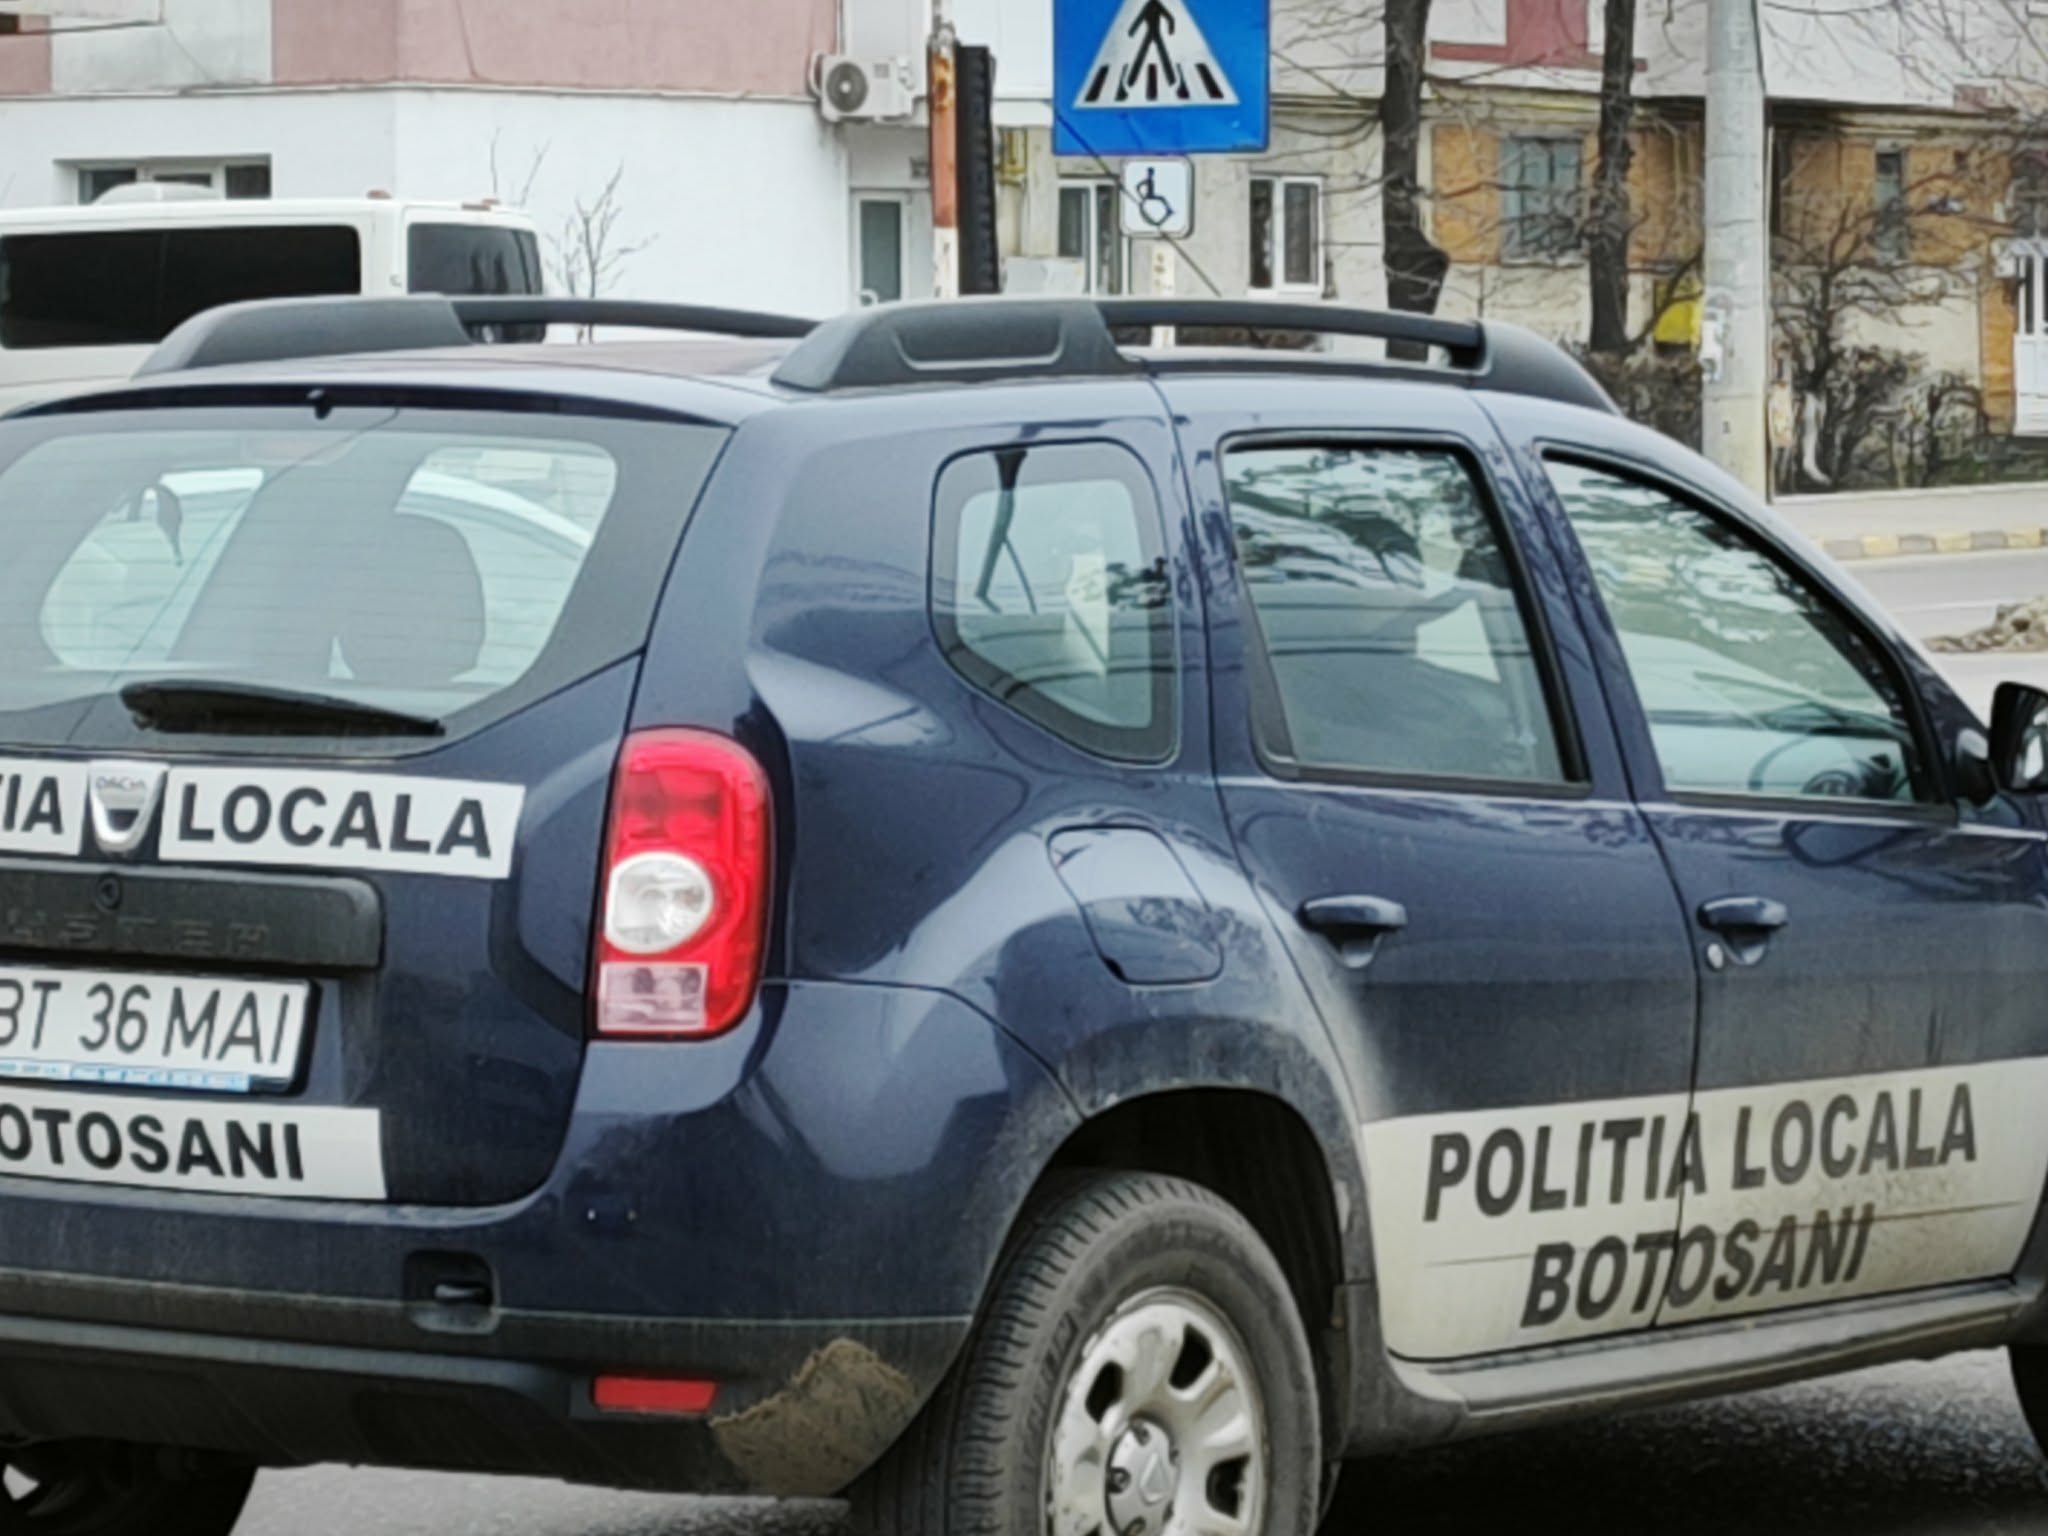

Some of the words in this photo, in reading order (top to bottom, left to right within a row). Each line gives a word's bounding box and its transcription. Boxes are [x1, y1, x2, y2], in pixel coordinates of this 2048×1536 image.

[0, 773, 63, 835] IA
[178, 783, 492, 859] LOCALA
[79, 981, 151, 1054] 36
[162, 986, 290, 1064] MAI
[0, 1103, 304, 1181] OTOSANI
[1423, 1112, 1707, 1222] POLITIA
[1731, 1083, 1977, 1191] LOCALA
[1520, 1202, 1875, 1329] BOTOSANI
